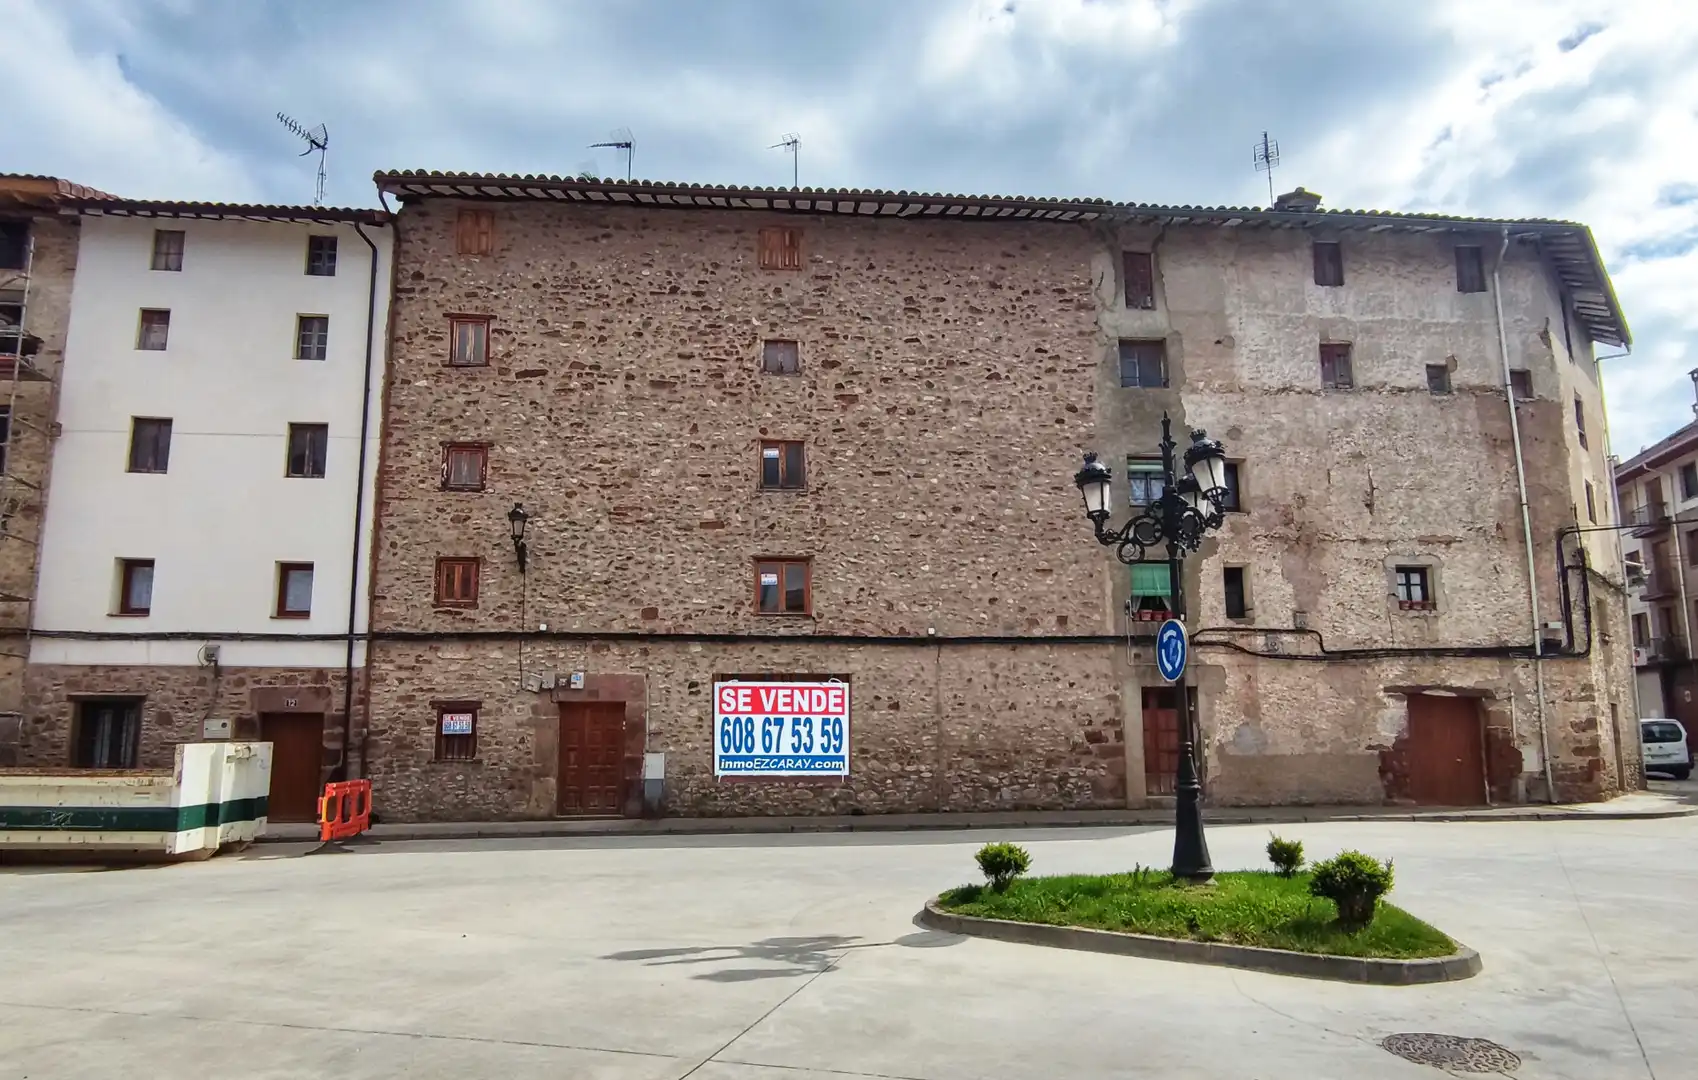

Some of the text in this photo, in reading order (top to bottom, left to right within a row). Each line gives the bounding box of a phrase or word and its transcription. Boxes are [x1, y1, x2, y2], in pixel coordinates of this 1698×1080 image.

[721, 688, 843, 713] SE VENDE
[720, 716, 844, 754] 608 67 53 59
[720, 758, 844, 769] inmoEZCARAY.com
